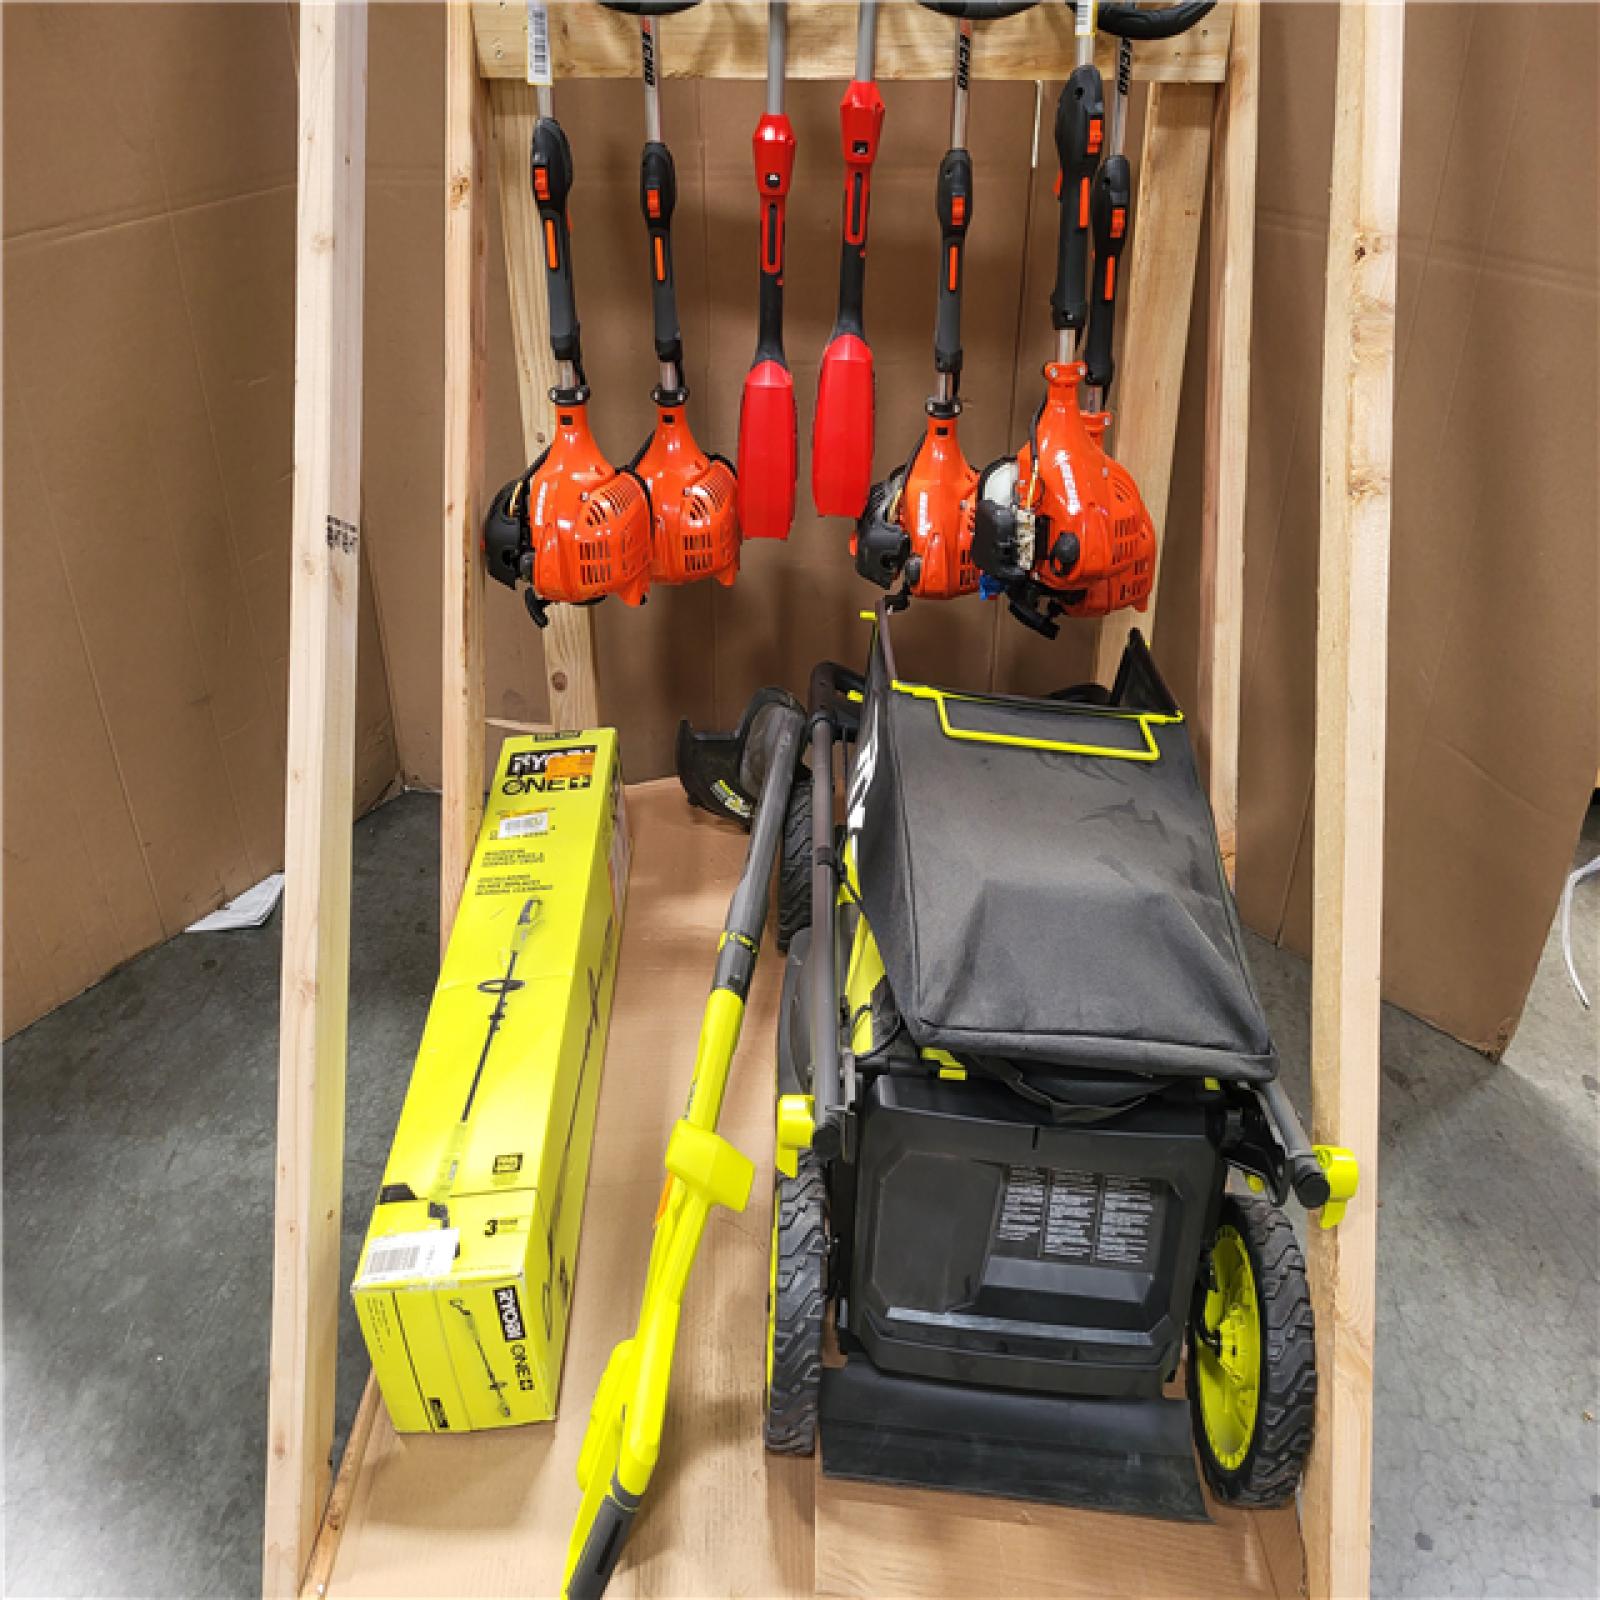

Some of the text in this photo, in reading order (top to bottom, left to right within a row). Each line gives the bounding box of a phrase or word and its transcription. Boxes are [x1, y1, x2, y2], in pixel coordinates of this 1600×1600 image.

[642, 31, 655, 86] ECHO
[957, 34, 970, 90] ECHO
[1118, 37, 1131, 95] ECHO
[484, 1219, 498, 1236] 3
[495, 1287, 525, 1340] RYOBI
